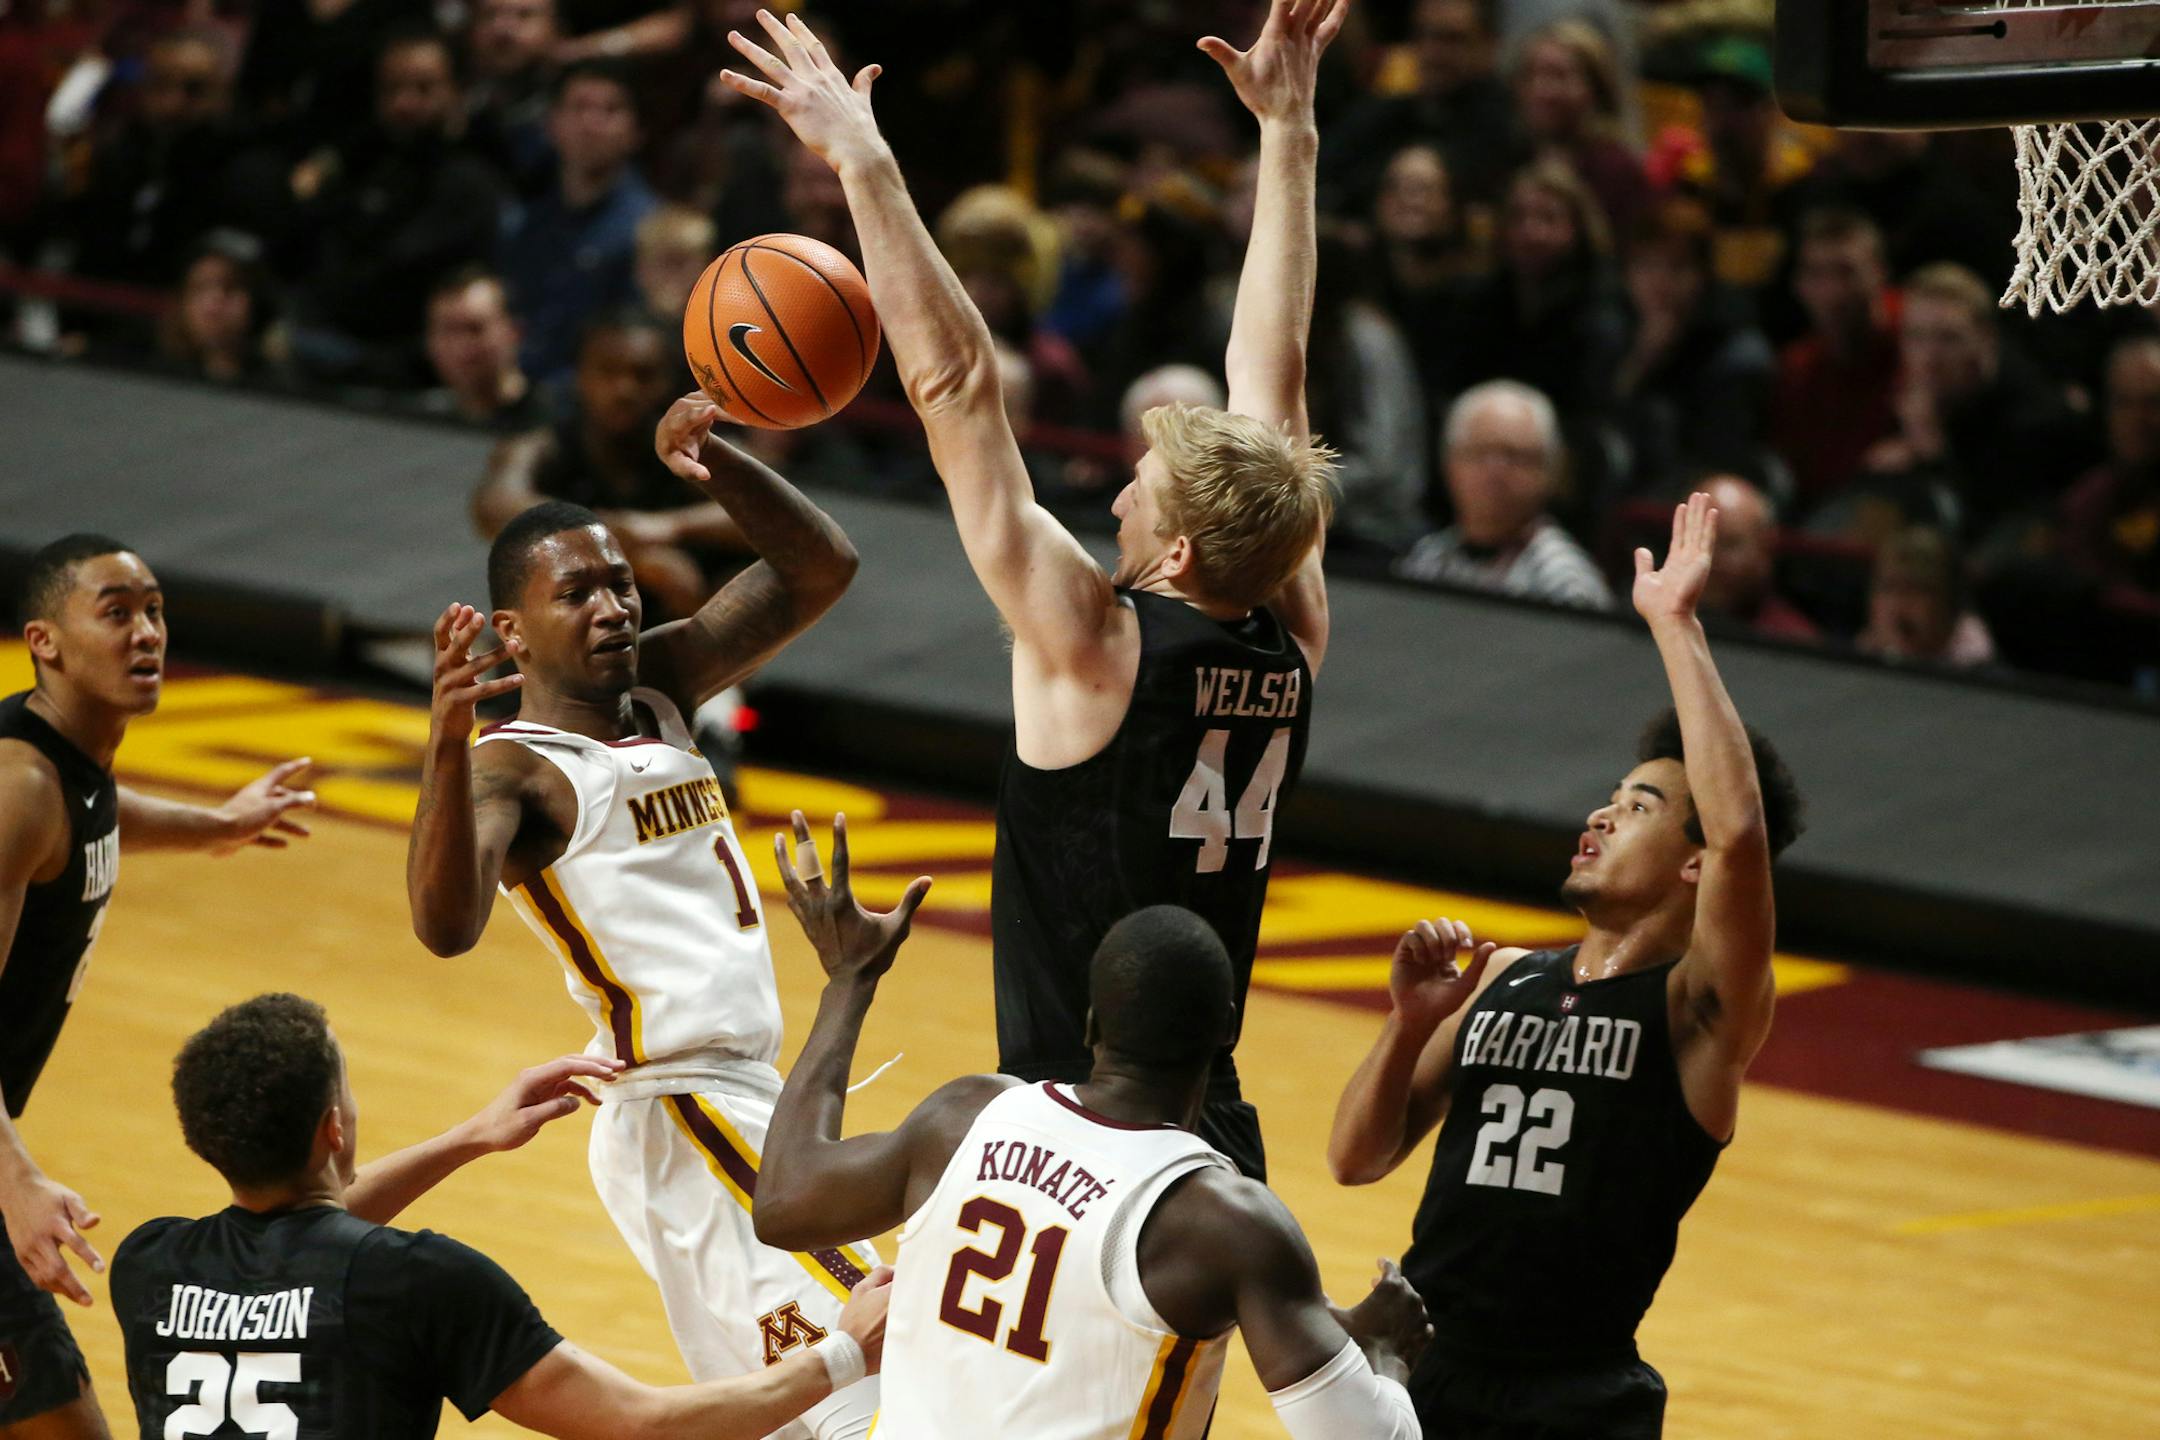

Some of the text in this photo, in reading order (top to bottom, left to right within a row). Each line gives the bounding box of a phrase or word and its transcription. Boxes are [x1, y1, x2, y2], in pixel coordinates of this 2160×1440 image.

[1195, 667, 1300, 718] WELSH
[1169, 727, 1292, 873] 44
[713, 832, 760, 929] 1
[1461, 1010, 1642, 1080] HARVARD
[977, 1140, 1115, 1221] KONATÉ
[1465, 1083, 1575, 1196] 22
[156, 1284, 314, 1340] JOHNSON
[939, 1195, 1071, 1365] 21
[757, 1300, 828, 1367] M
[164, 1351, 301, 1440] 25
